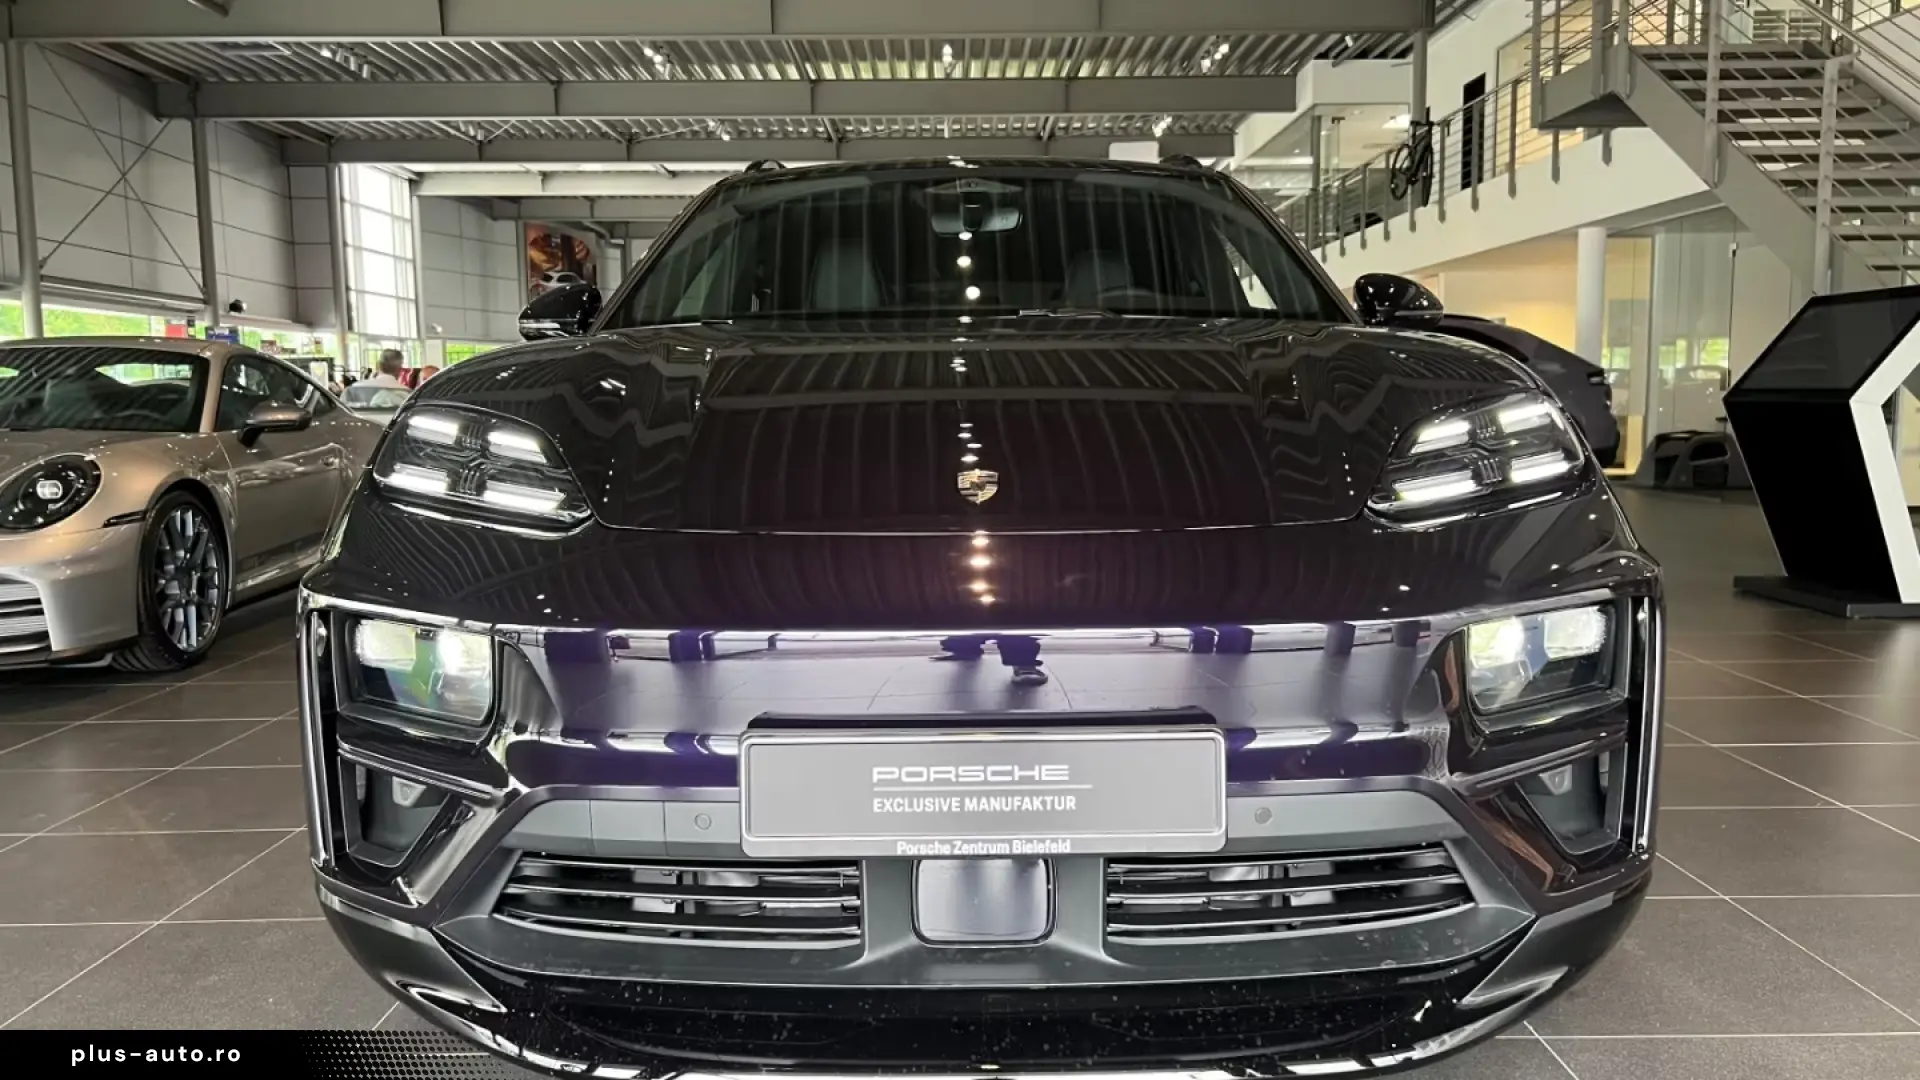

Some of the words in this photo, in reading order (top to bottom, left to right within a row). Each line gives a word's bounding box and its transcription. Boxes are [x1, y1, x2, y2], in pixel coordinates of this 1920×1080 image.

[872, 765, 1070, 783] PORSCHE
[873, 797, 961, 813] EXCLUSIVE
[964, 795, 1077, 812] MANUFAKTUR
[896, 841, 950, 855] Porsche
[952, 840, 1009, 855] Zentrum
[1012, 839, 1071, 854] Bielefeld
